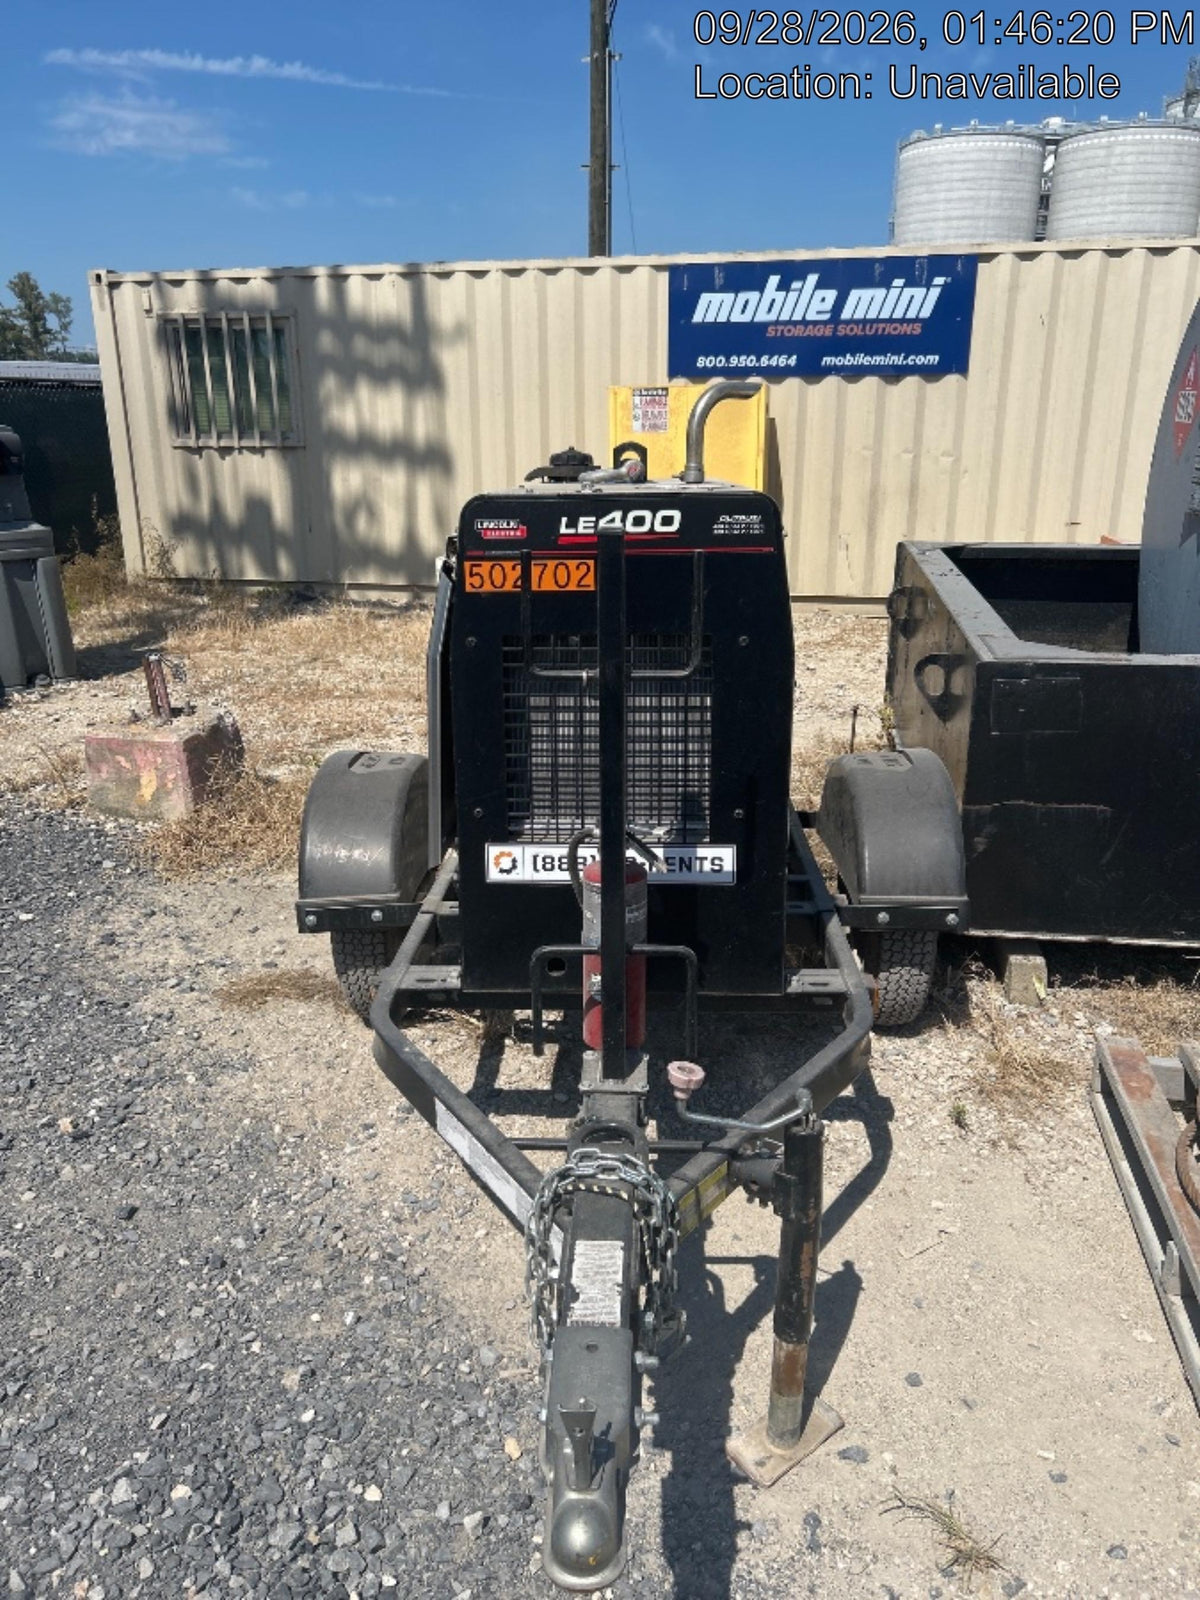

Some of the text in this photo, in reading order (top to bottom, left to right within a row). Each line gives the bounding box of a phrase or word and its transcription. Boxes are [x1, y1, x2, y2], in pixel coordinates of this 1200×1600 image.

[691, 273, 947, 323] mobile mini
[766, 322, 922, 338] STORAGE SOLUTIONS
[696, 354, 797, 368] 800.950.6464
[820, 353, 940, 367] mobilemini.com
[559, 509, 682, 534] LE400
